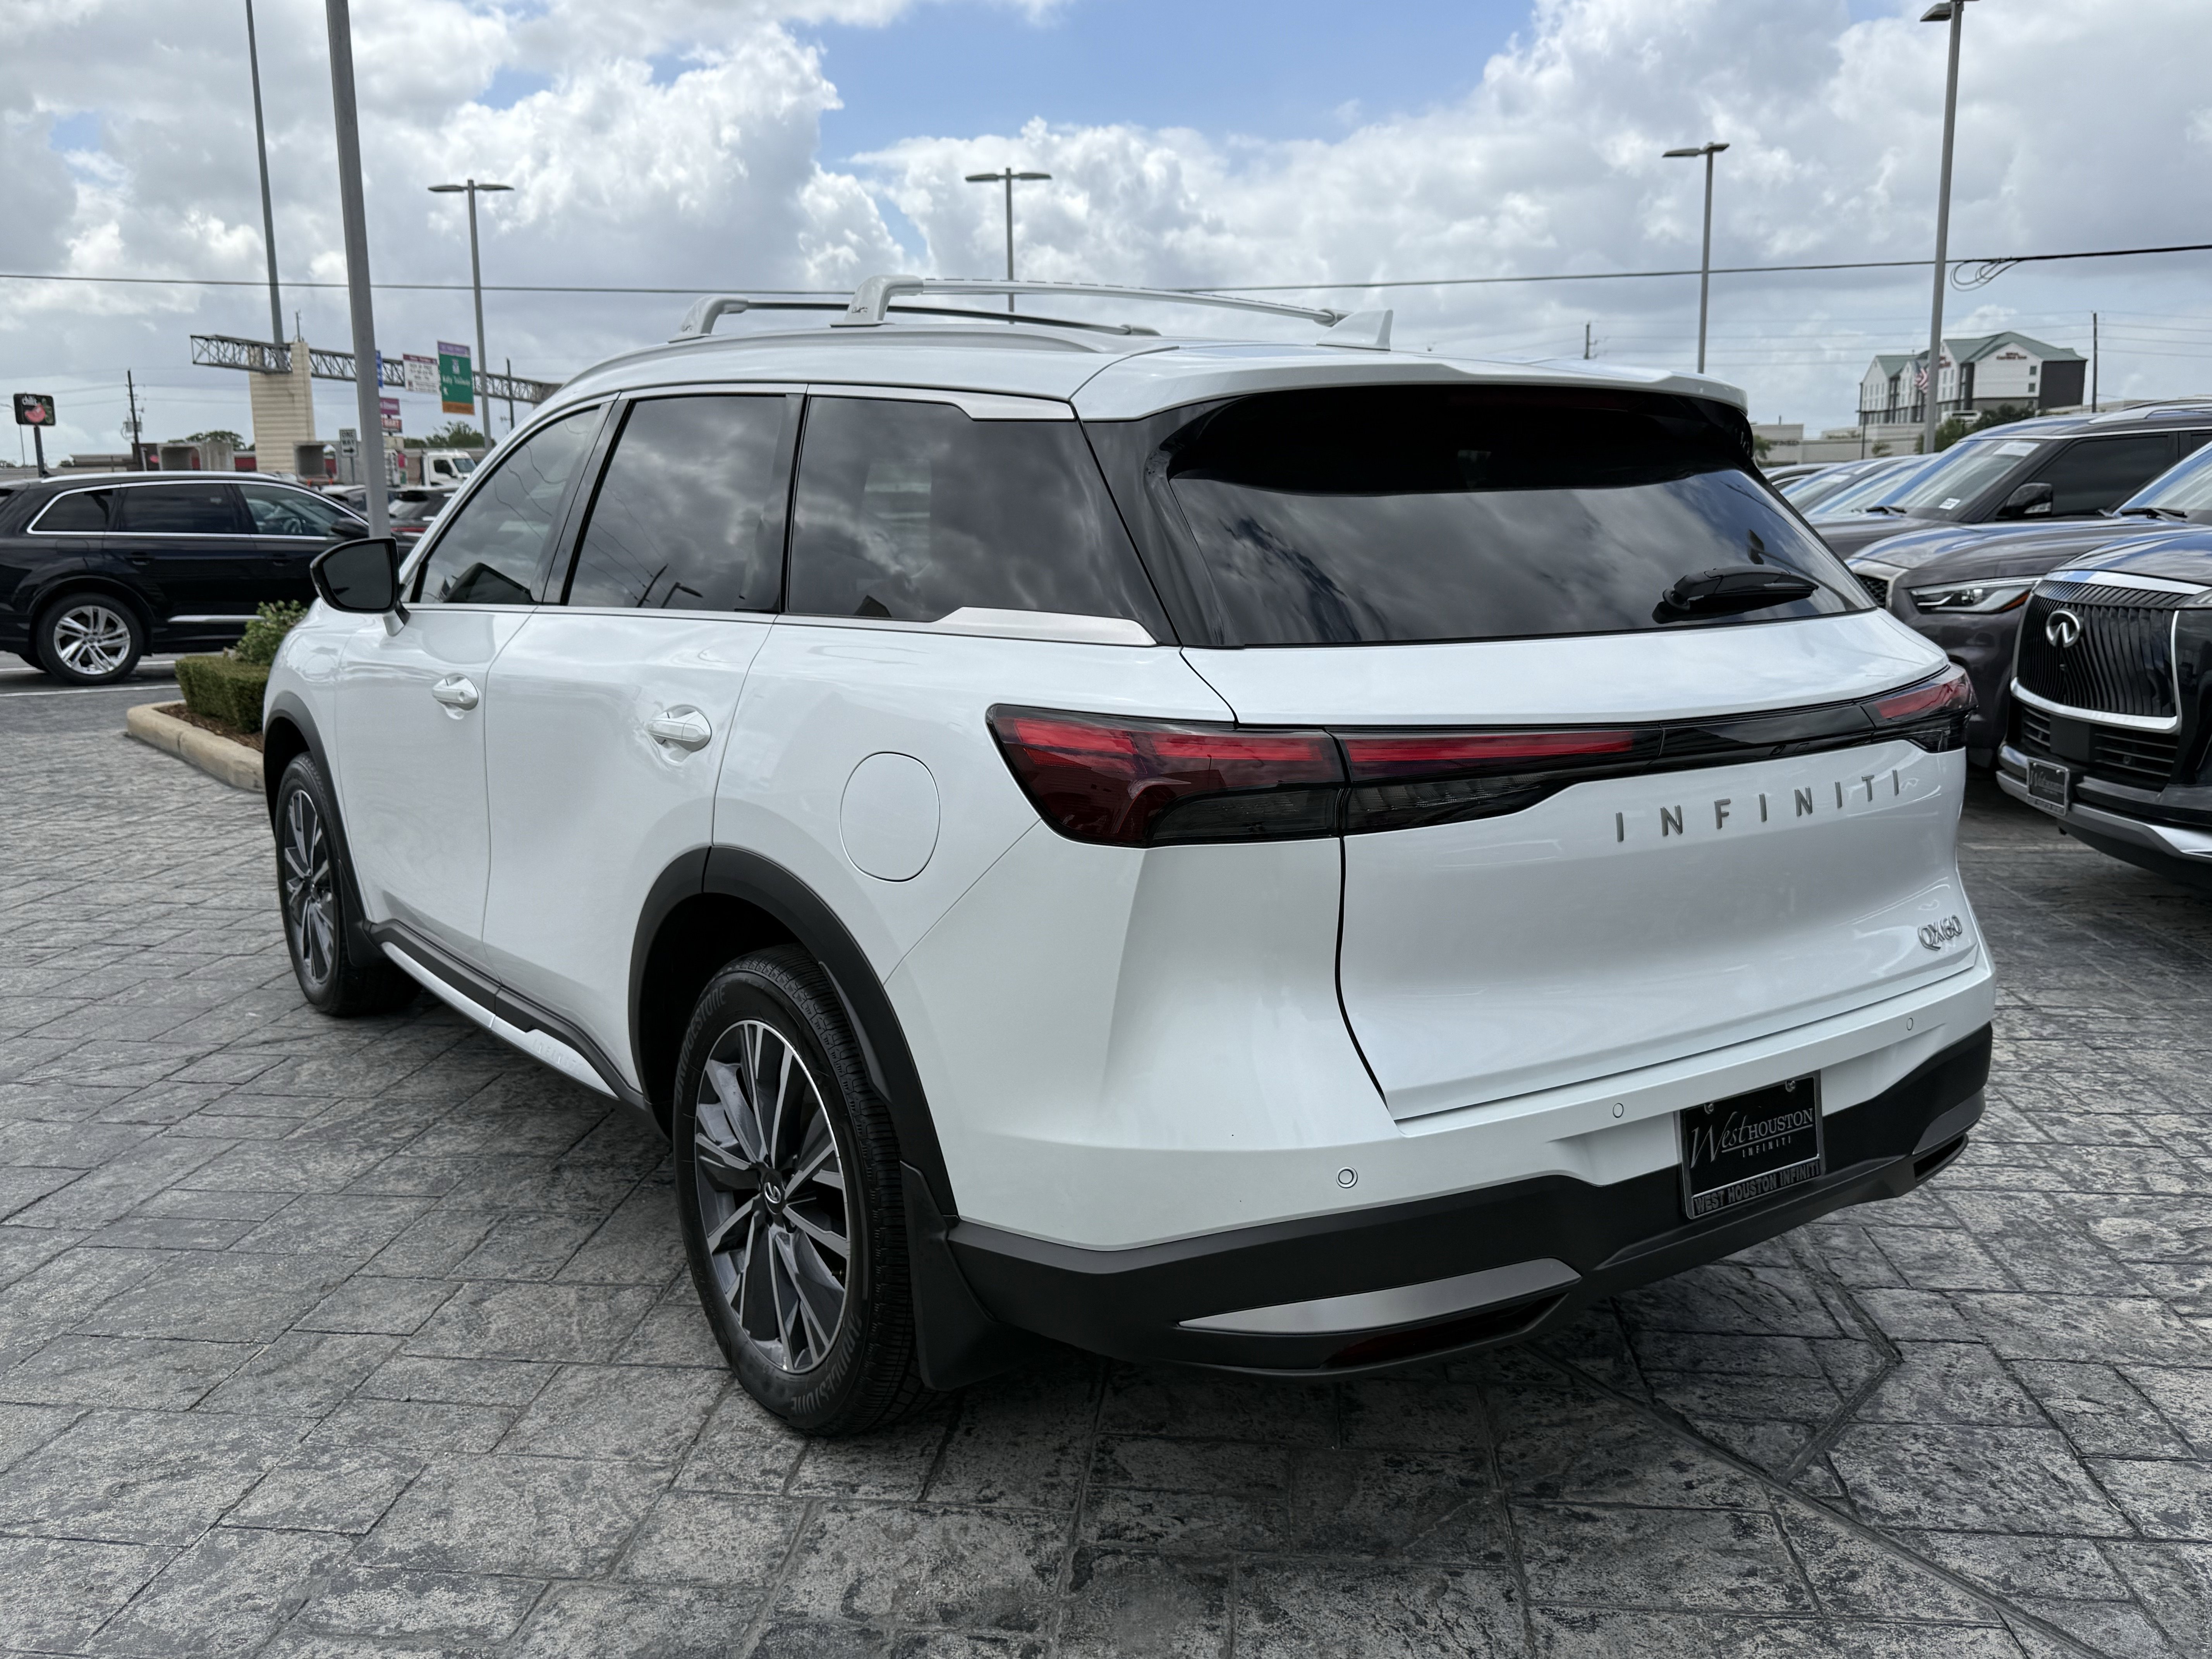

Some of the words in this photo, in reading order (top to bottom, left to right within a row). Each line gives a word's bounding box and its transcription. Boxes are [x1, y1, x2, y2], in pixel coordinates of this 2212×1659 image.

[1616, 769, 1899, 842] INFINITI
[1917, 915, 1962, 951] QX60
[1690, 1111, 1747, 1169] West
[1748, 1108, 1814, 1140] HOUSTON
[1743, 1136, 1790, 1158] INFINITI
[1695, 1190, 1725, 1214] WEST
[1728, 1174, 1777, 1203] HOUSTON
[1780, 1161, 1820, 1187] INFINITI
